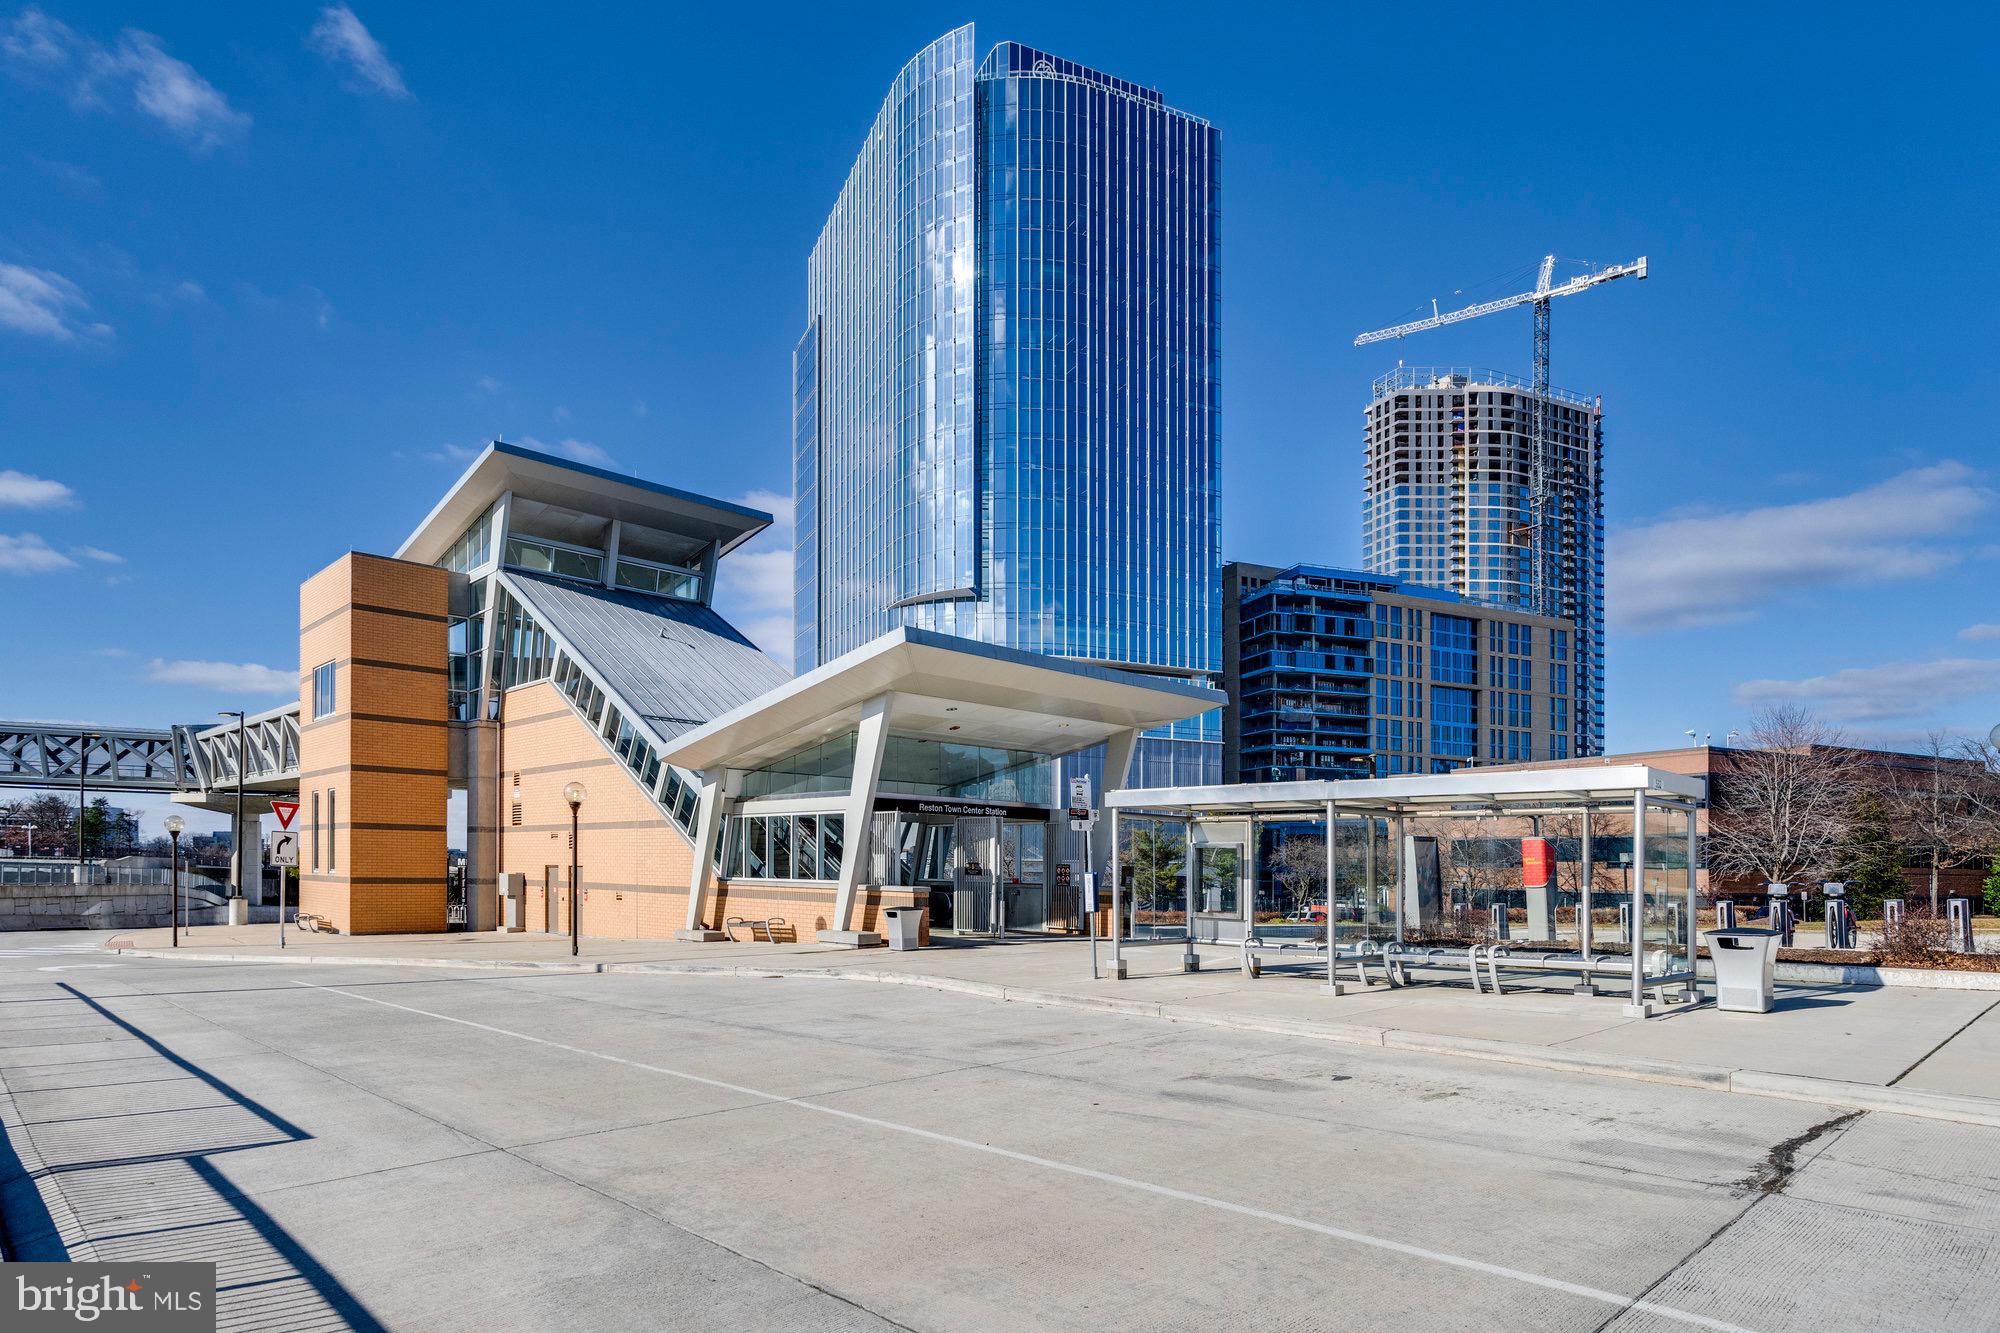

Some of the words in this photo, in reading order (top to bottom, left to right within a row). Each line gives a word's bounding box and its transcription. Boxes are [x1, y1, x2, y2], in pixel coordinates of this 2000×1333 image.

[919, 803, 943, 812] Reston
[944, 804, 962, 813] Town
[963, 806, 984, 815] Center
[985, 807, 1007, 816] Station
